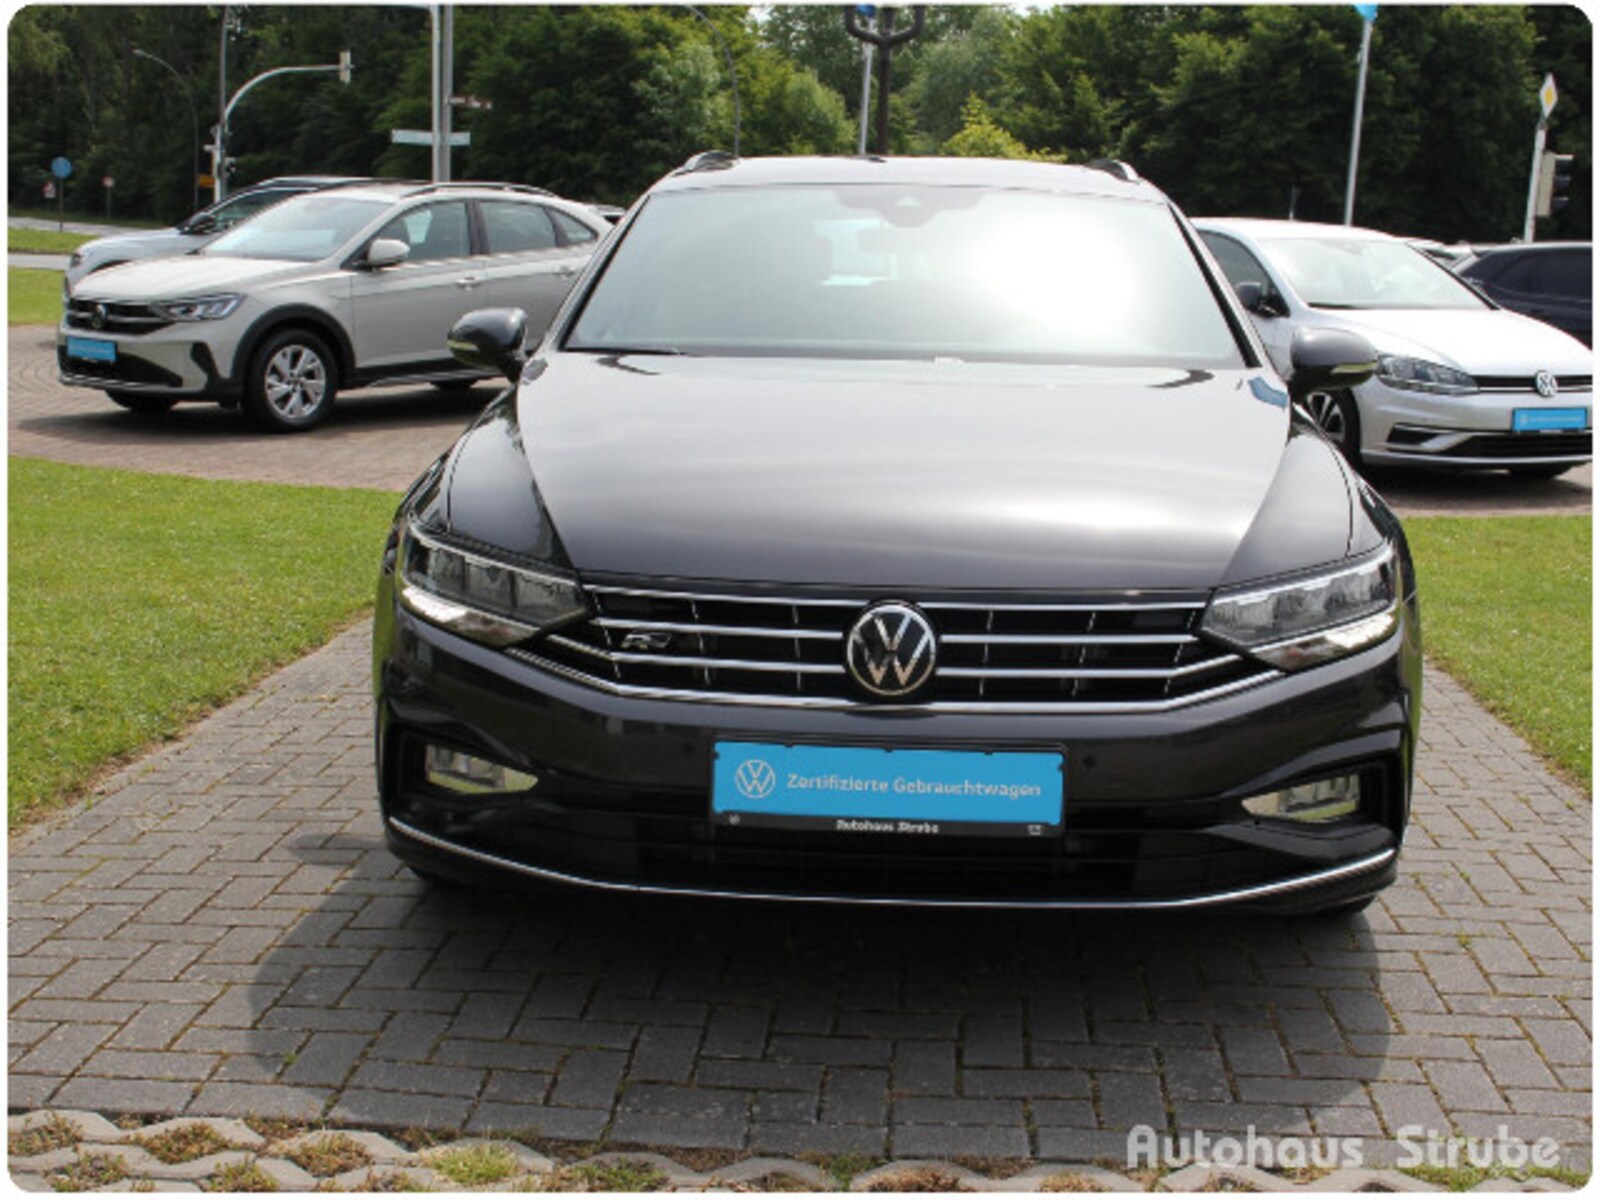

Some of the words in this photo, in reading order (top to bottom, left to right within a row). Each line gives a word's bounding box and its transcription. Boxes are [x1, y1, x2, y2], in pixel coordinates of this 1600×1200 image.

[847, 604, 936, 696] VW
[735, 759, 776, 798] VW
[787, 773, 889, 793] Zertifizierte
[893, 777, 1041, 799] Gebrauchtwagen
[836, 819, 894, 832] Autohaus
